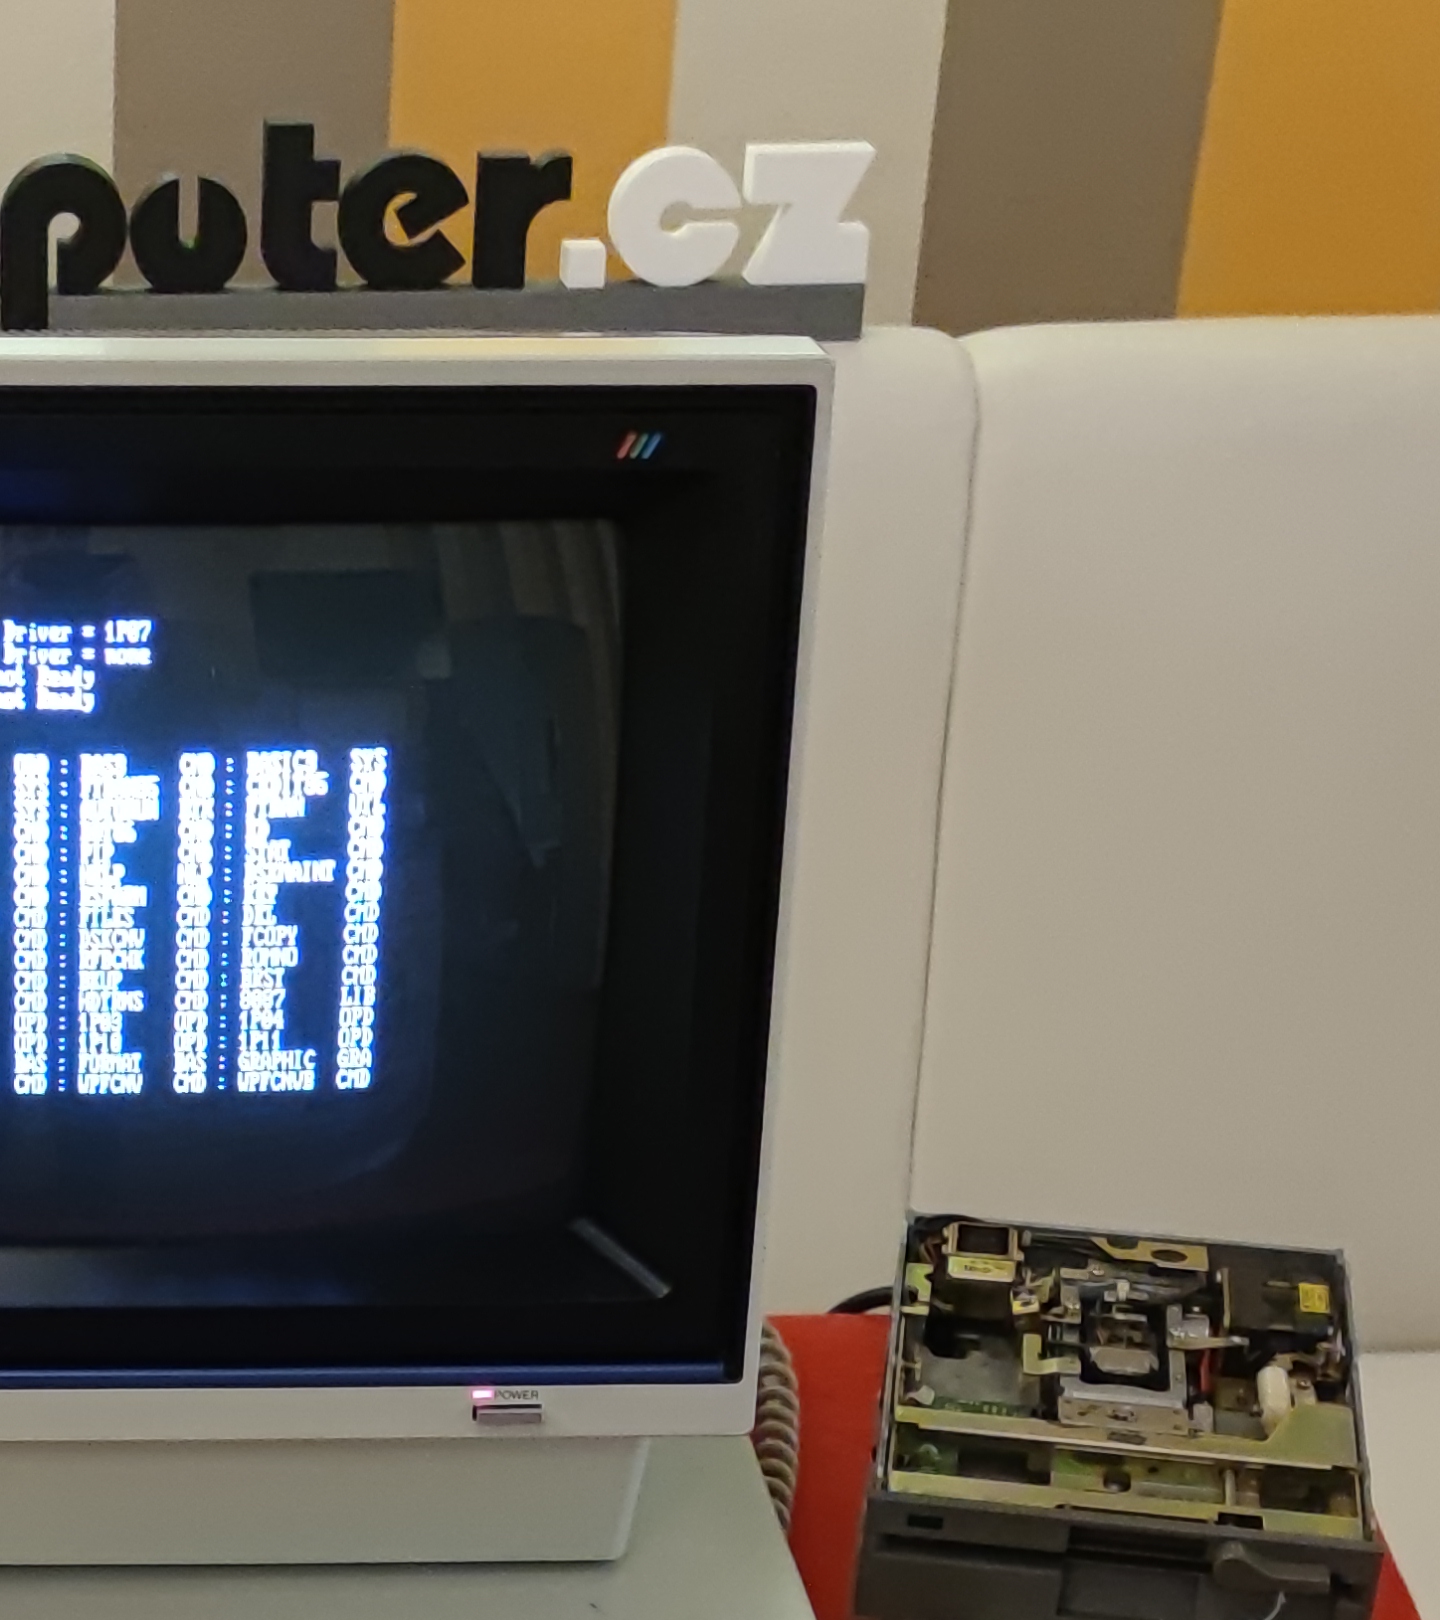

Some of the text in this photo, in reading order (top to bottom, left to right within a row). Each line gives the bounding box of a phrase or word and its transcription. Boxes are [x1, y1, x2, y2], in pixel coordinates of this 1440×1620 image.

[4, 620, 71, 644] Driver
[4, 644, 72, 665] Driver
[105, 648, 151, 664] none
[239, 1050, 316, 1071] GRAPHIC
